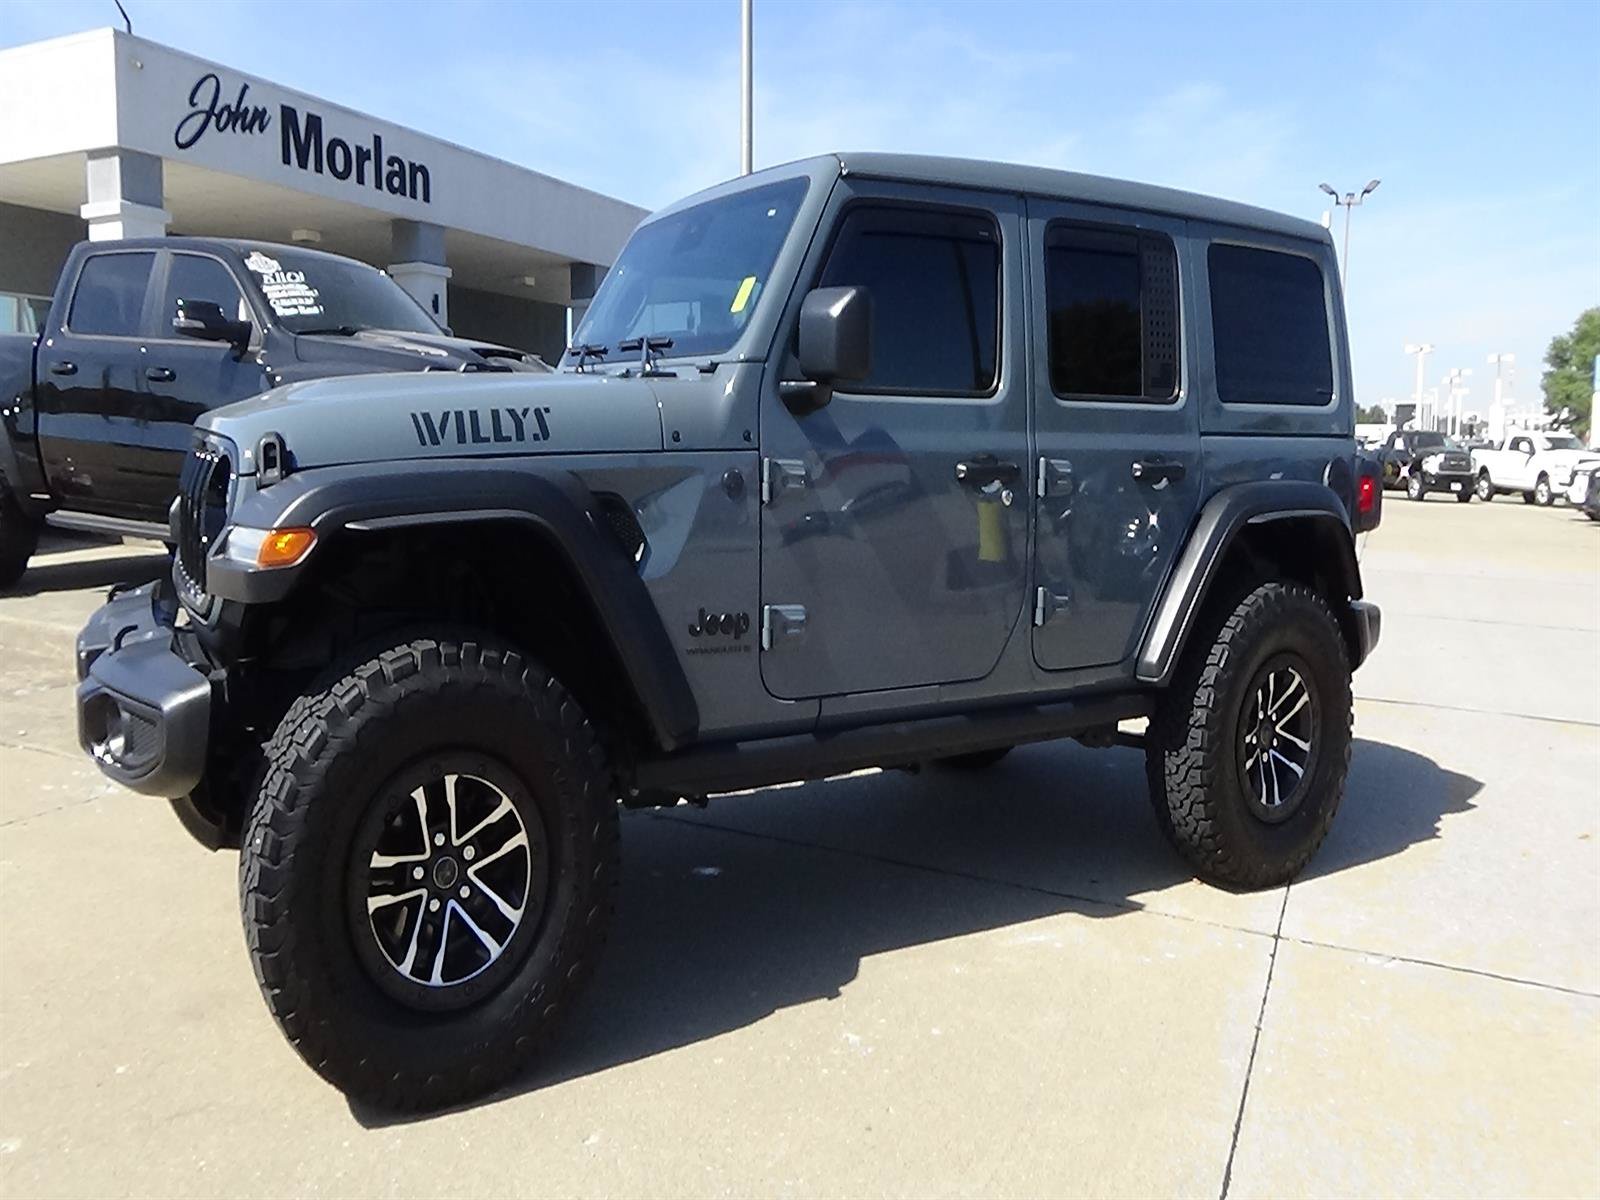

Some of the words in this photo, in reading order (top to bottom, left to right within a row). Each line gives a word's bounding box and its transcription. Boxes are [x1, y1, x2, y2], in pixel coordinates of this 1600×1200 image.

[174, 73, 272, 150] John
[280, 104, 431, 203] Morlan
[410, 406, 551, 446] WILLYS
[688, 606, 750, 640] Jeep
